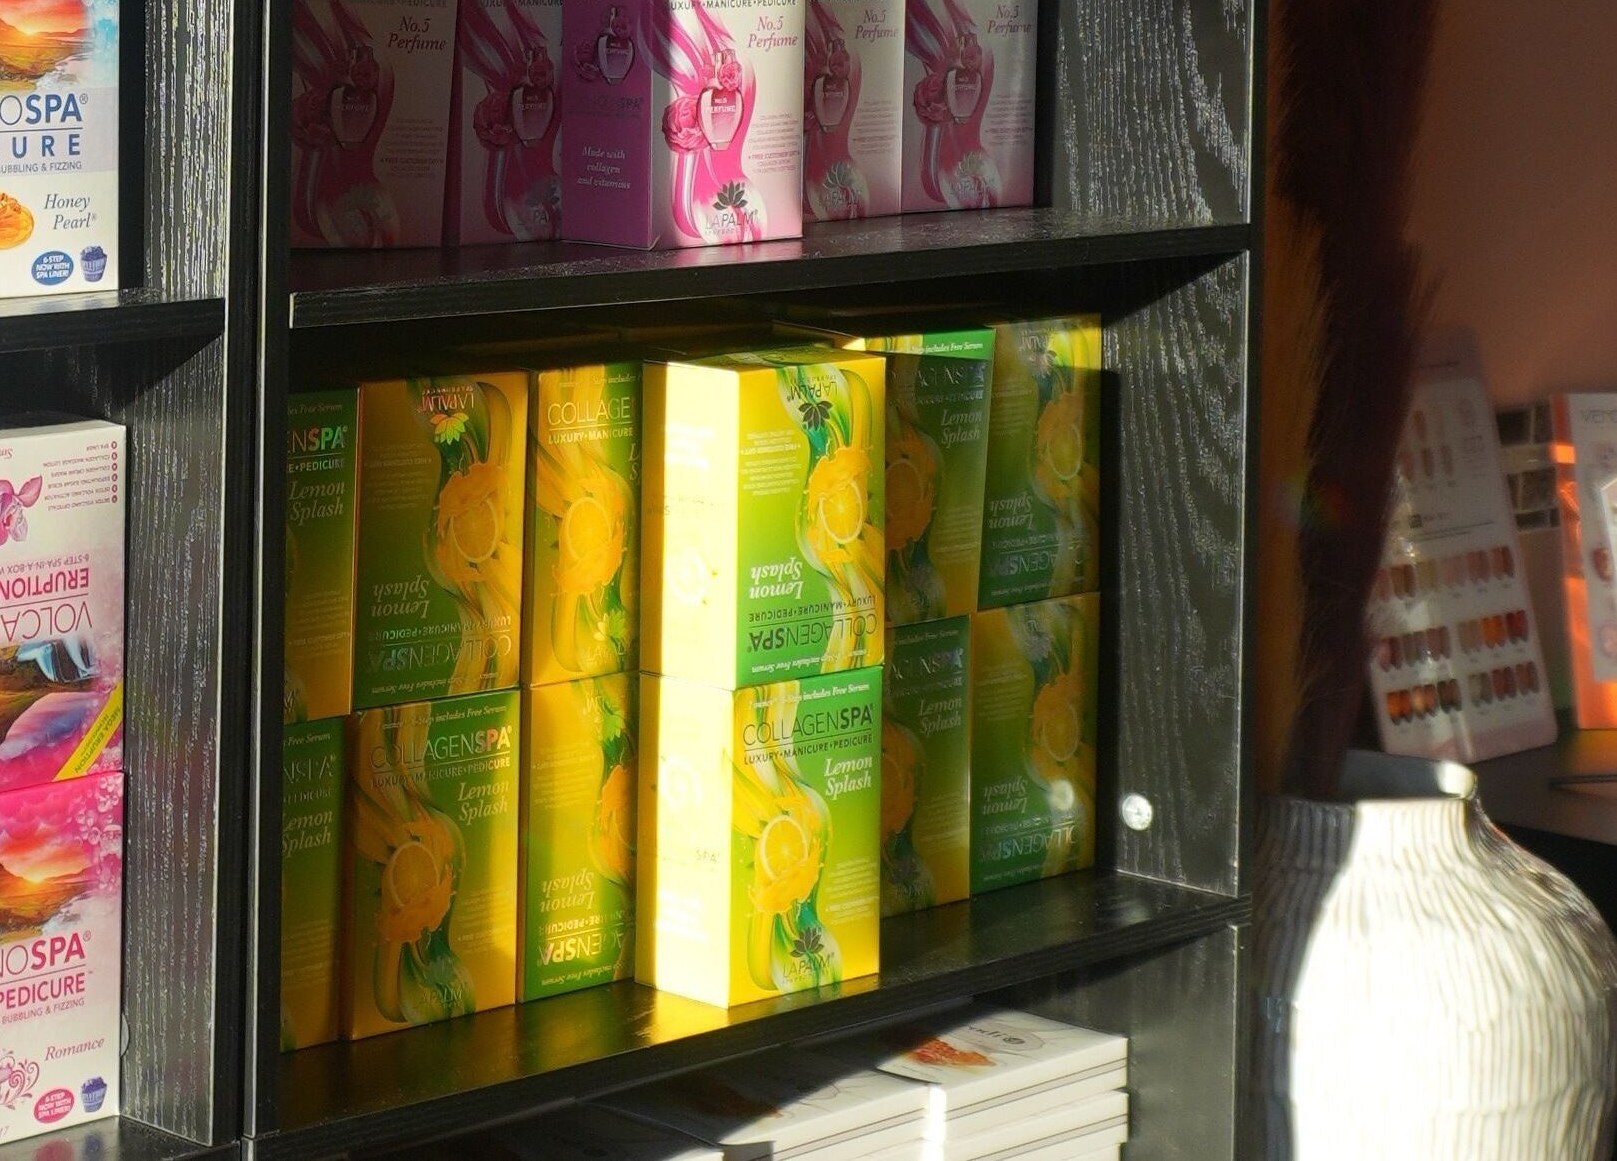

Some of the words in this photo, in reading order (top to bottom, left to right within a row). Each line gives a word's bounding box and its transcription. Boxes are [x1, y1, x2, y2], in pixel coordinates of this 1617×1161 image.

[757, 17, 783, 31] No.5
[748, 34, 797, 52] Perfume
[44, 194, 90, 211] Honey
[940, 410, 982, 426] Lemon
[941, 427, 982, 447] Splash
[289, 479, 345, 499] Lemon
[290, 502, 344, 526] Splash
[751, 557, 802, 584] Splash
[750, 581, 804, 599] Lemon
[833, 686, 846, 696] Free
[824, 756, 873, 777] Lemon
[457, 781, 510, 801] Lemon
[825, 771, 872, 800] Splash
[459, 801, 508, 826] Splash
[543, 868, 594, 897] Splash
[541, 891, 595, 912] Lemon
[44, 1039, 105, 1061] Romance
